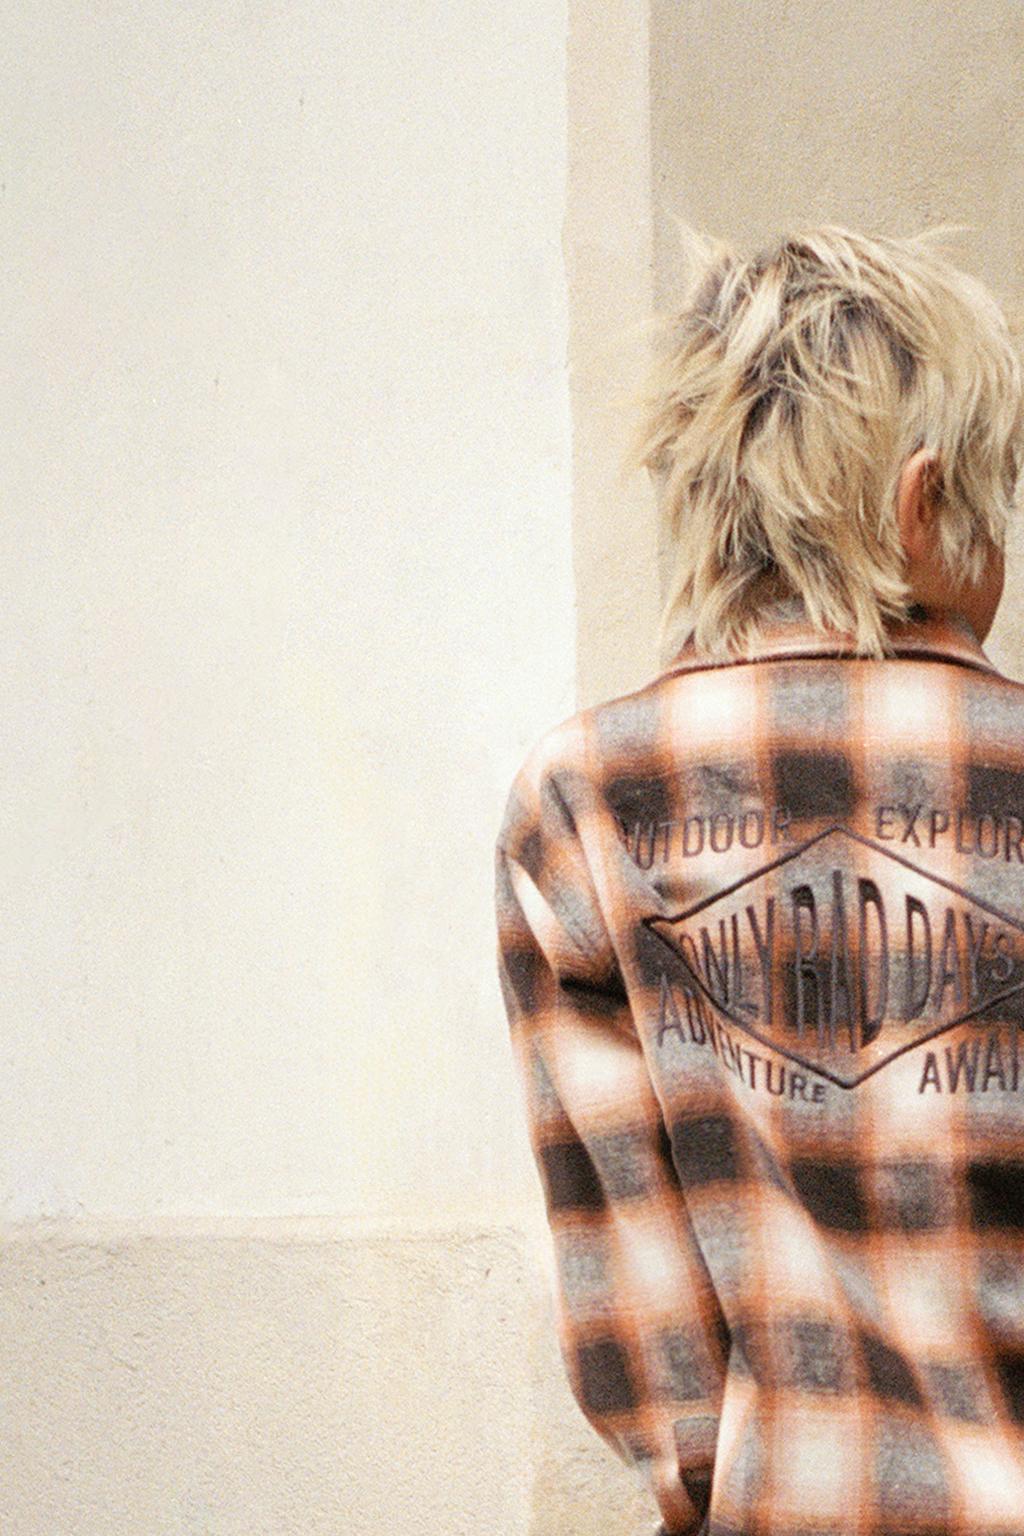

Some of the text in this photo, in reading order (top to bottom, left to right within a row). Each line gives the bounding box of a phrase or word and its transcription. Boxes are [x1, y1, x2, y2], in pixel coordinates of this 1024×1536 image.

[624, 805, 792, 870] UTDOOR
[679, 896, 774, 1026] ONLY
[905, 894, 1014, 1025] DAYS
